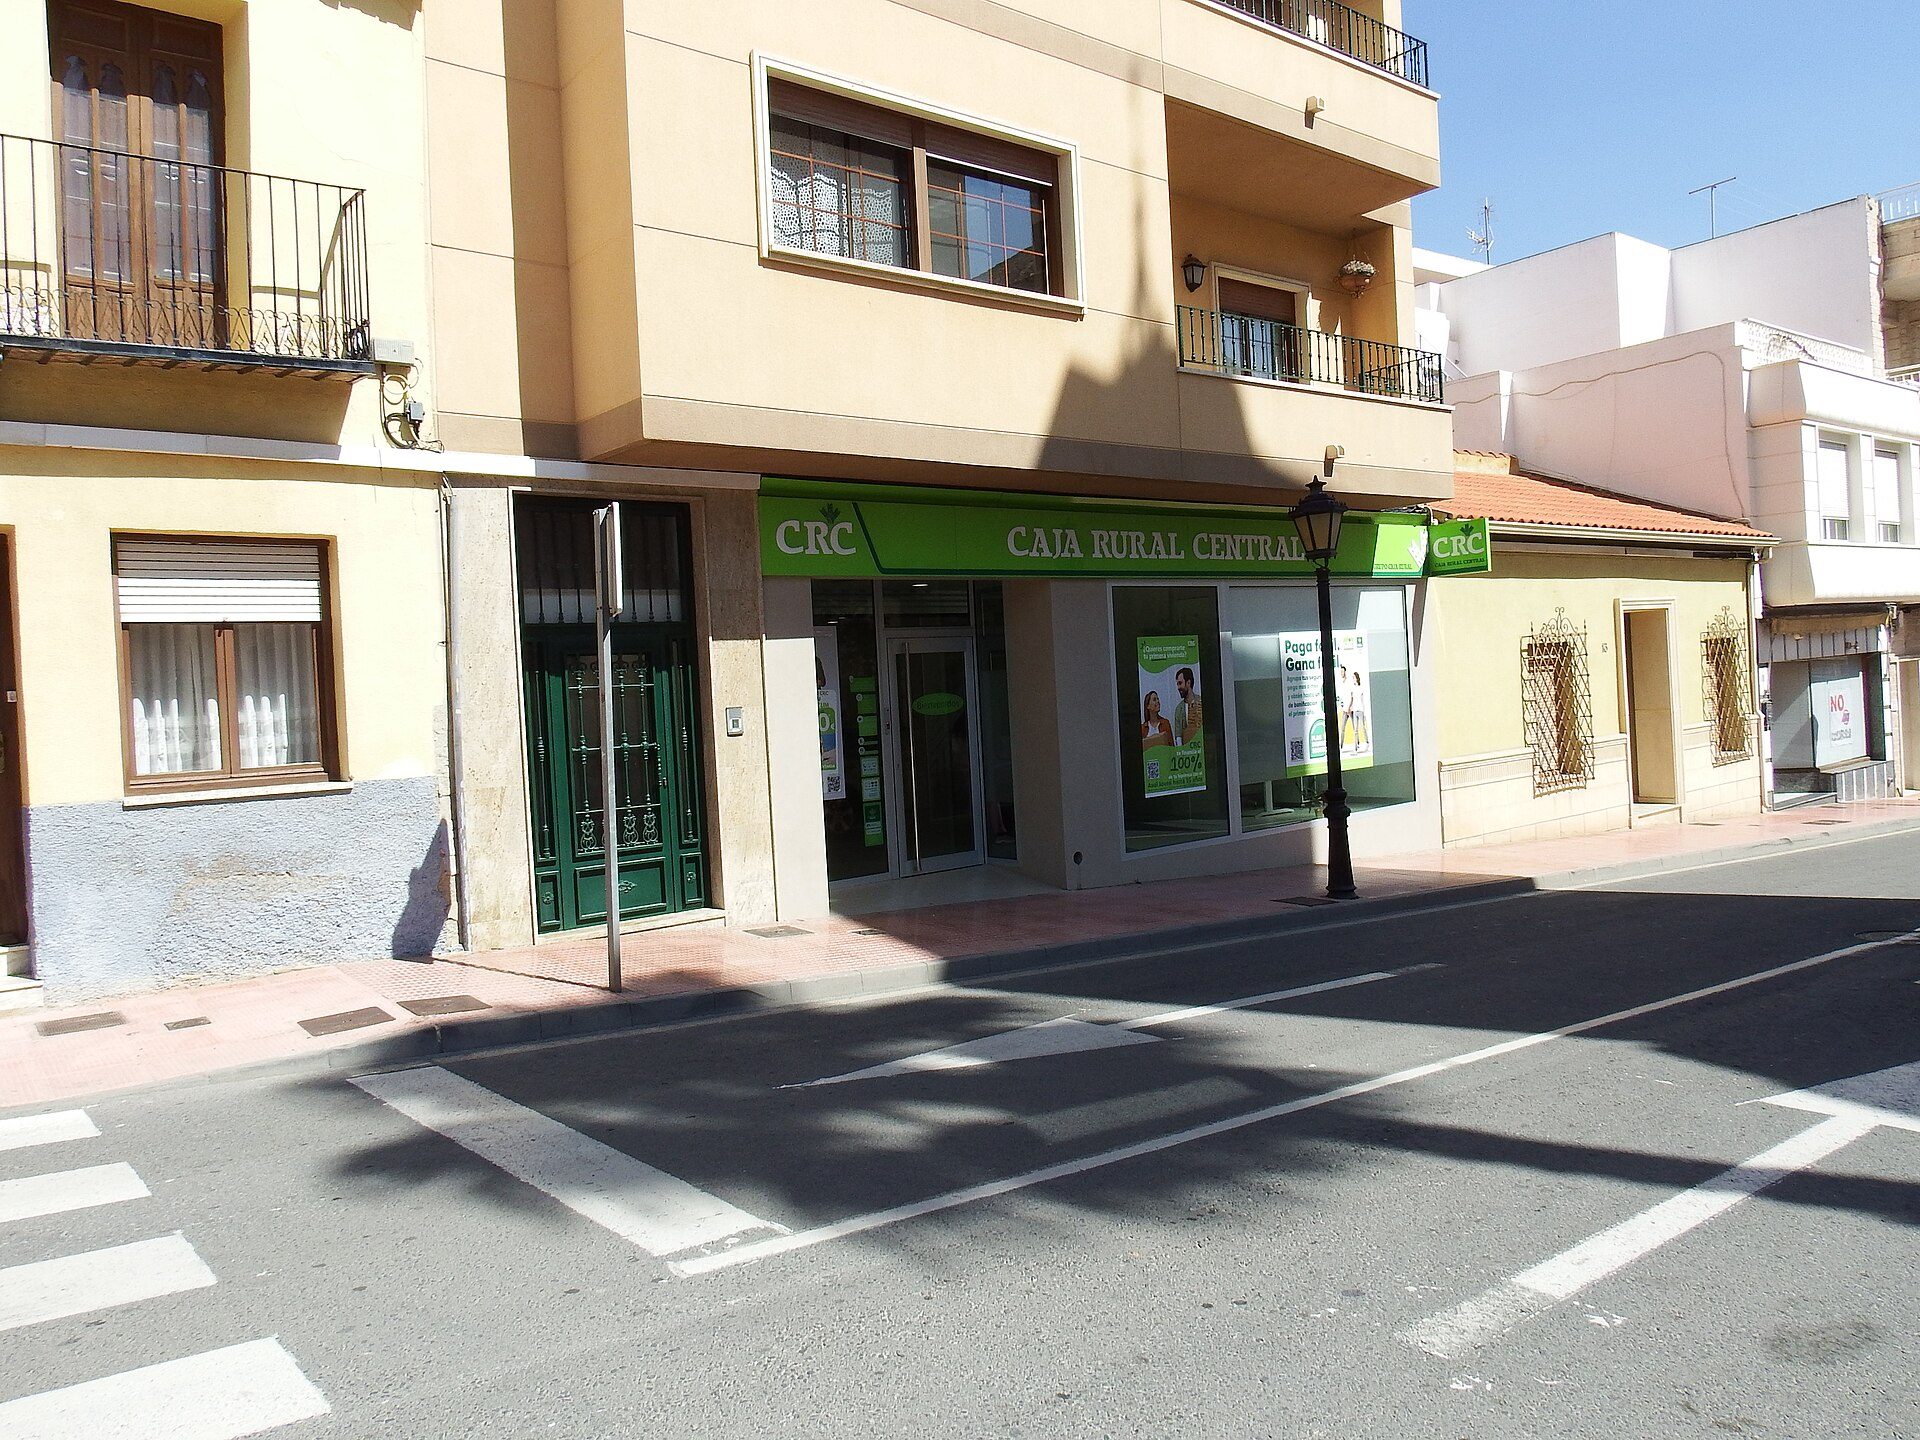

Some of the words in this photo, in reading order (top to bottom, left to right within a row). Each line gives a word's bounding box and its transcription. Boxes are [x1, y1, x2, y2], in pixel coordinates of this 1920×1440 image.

[775, 519, 857, 555] CRC
[1006, 526, 1084, 559] CAJA
[1091, 530, 1185, 560] RURAL
[1192, 533, 1305, 561] CENTRAL
[1432, 532, 1485, 558] CRC
[1285, 639, 1313, 656] Paga
[1285, 657, 1315, 671] Gana
[1829, 694, 1845, 713] NO
[1190, 741, 1201, 749] CRC
[1171, 754, 1202, 772] 100%
